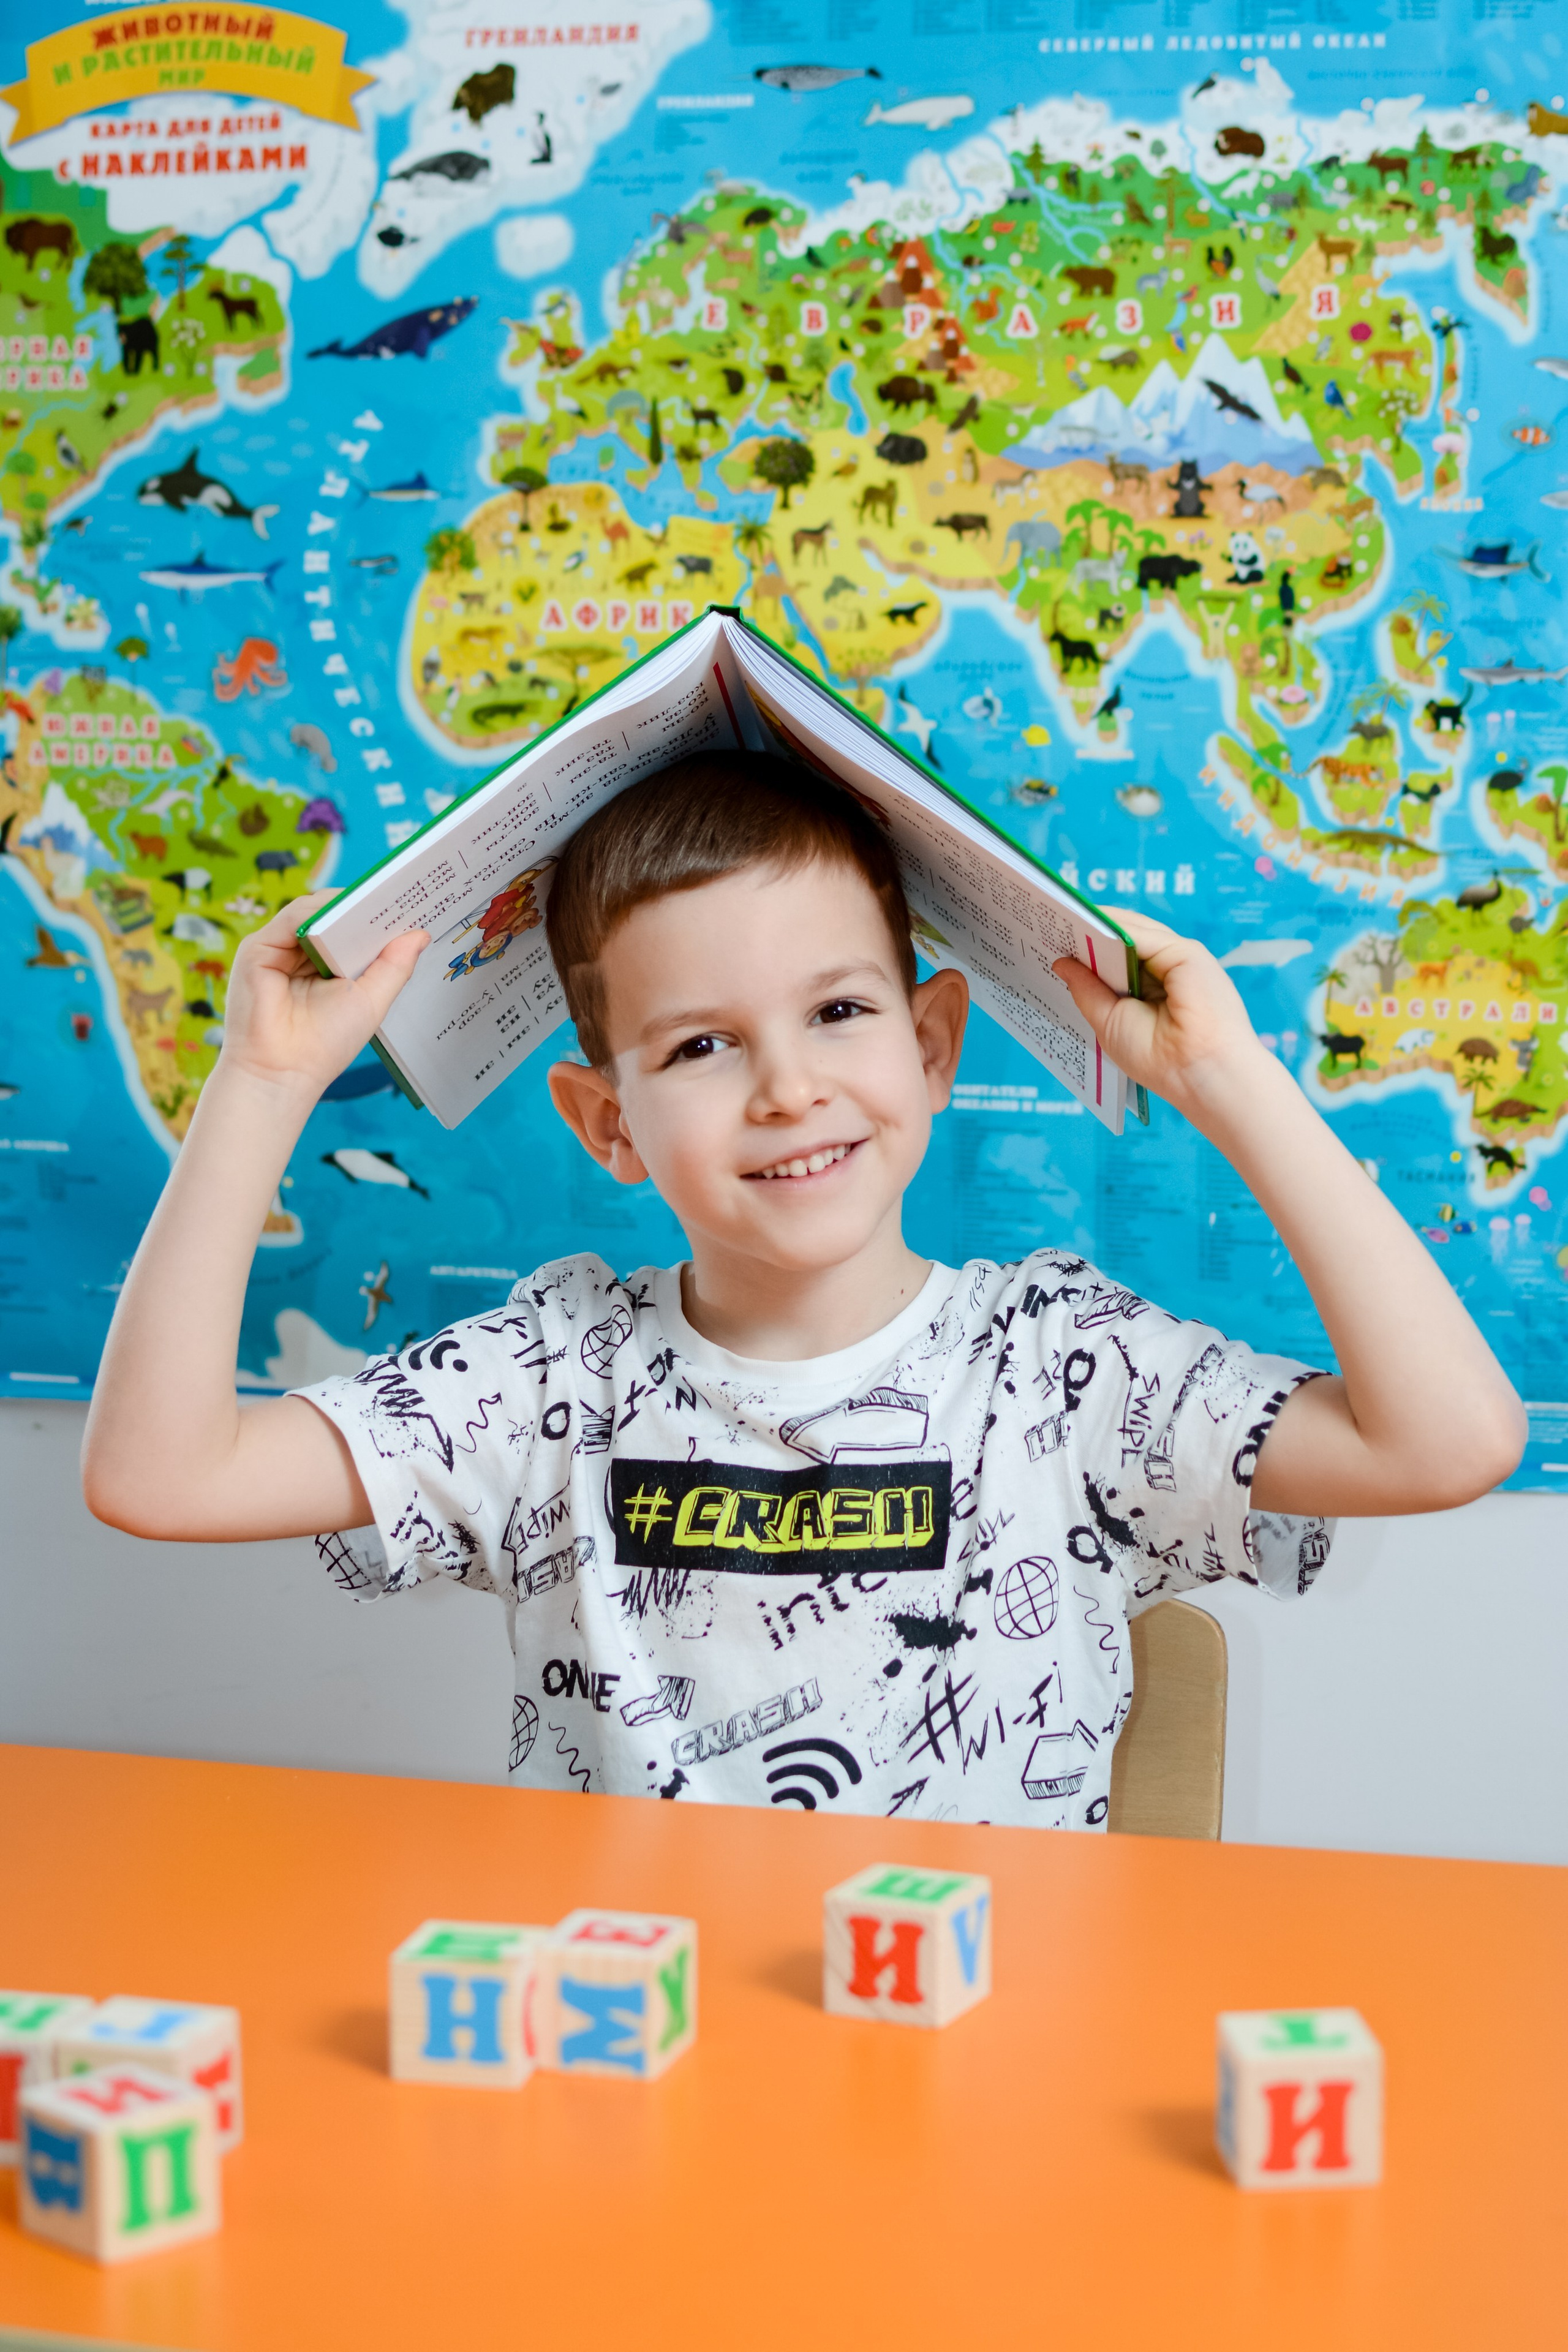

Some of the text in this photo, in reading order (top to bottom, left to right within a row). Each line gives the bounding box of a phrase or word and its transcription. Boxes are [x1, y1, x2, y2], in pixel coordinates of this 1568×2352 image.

[92, 12, 276, 50] ЖИВОТНЫЙ
[465, 23, 641, 48] ГРЕНЛАНДИЯ
[1039, 31, 1387, 53] СЕВЕРНЫЙ ЛЕДОВИТЫЙ ОКЕАН
[53, 39, 316, 86] И РАСТИТЕЛЬНЫЙ
[159, 69, 205, 88] МИР
[90, 108, 282, 139] КАРТА ДЛЯ ДЕТЕЙ
[81, 141, 308, 178] НАКЛЕЙКАМИ
[0, 336, 91, 361] РНАЯ
[0, 366, 88, 389] РИКА
[541, 600, 693, 630] АФРИК
[637, 682, 703, 728] коз-лик
[662, 697, 709, 732] ко-зы
[665, 690, 706, 722] ко-за
[29, 741, 176, 766] АМЕРИКА
[556, 740, 611, 776] та-зик
[587, 747, 614, 762] таз
[638, 728, 693, 760] Ли-зы
[566, 764, 627, 804] сан-ки.
[570, 753, 617, 783] та-зы
[421, 718, 717, 929] На-сту-пи-ла зи-ма. Ста-ло мо-роз
[472, 793, 533, 844] зон-тик
[486, 807, 539, 851] зон-ты
[502, 800, 536, 830] зонт
[535, 814, 556, 831] На
[464, 839, 526, 886] сан-ках
[1060, 861, 1196, 894] ЙСКИЙ
[370, 860, 448, 924] мо-роз-но
[385, 873, 456, 930] мо-ро-зы
[397, 867, 453, 909] мо-роз
[404, 893, 454, 931] Зи-на.
[501, 947, 541, 981] зи-ма
[506, 952, 547, 986] Зи-на
[533, 974, 551, 992] зу
[537, 981, 556, 1000] уз
[437, 990, 489, 1040] у-зо-ры
[459, 995, 494, 1030] у-зор
[496, 1006, 515, 1025] зи
[545, 995, 563, 1015] зу
[1355, 997, 1558, 1023] АВСТРАЛИ
[501, 1014, 520, 1033] из
[508, 1026, 530, 1048] зы
[475, 1061, 494, 1080] зи
[541, 1659, 620, 1712] ONE
[671, 1676, 823, 1765] CRASH
[846, 1912, 925, 2007] И
[420, 1972, 507, 2065] Н
[1262, 2077, 1354, 2173] И
[119, 2119, 200, 2236] П
